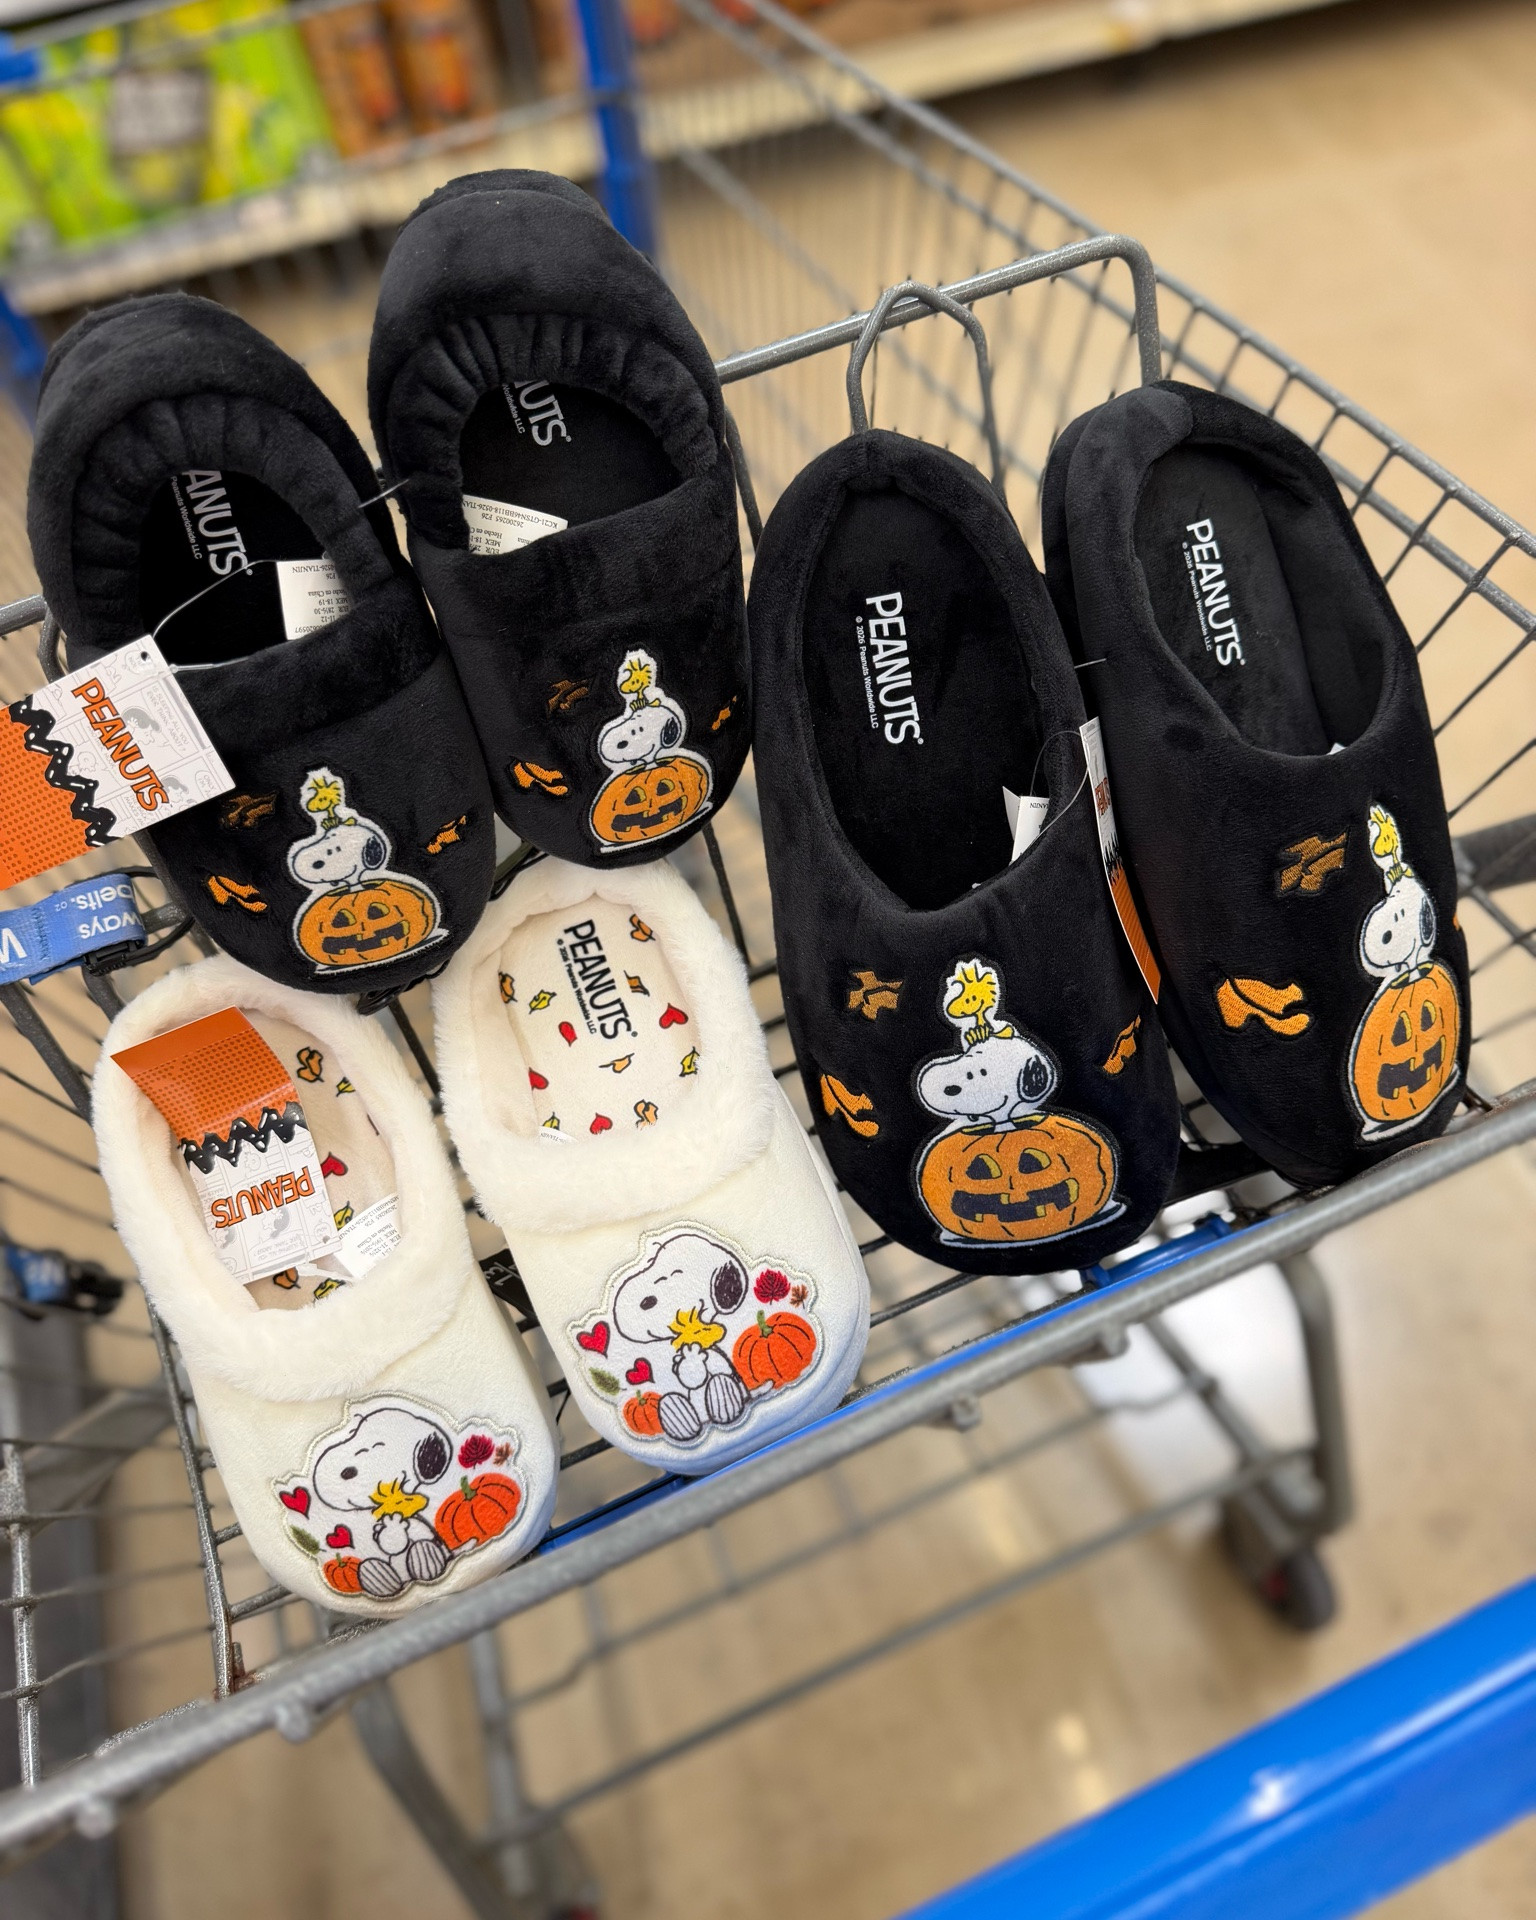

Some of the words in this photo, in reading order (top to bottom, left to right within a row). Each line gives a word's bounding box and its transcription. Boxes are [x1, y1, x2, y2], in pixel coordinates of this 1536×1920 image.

[514, 418, 526, 434] LLC
[480, 512, 492, 520] F26
[181, 506, 196, 543] Worldwide
[191, 543, 203, 560] LLC
[469, 534, 482, 543] 18-1
[483, 528, 502, 539] Hecho
[484, 538, 501, 547] MEX
[307, 589, 324, 598] China
[1187, 570, 1200, 599] Peanuts
[1194, 599, 1209, 635] Worldwide
[1203, 636, 1212, 651] LLC
[855, 625, 865, 644] 2026
[858, 645, 870, 675] Peanuts
[863, 675, 877, 713] Worldwide
[869, 713, 878, 728] LLC
[72, 678, 169, 812] PEANUTS
[178, 731, 189, 745] YOU
[81, 912, 143, 939] ways
[564, 963, 579, 988] Peanuts
[574, 988, 592, 1020] Worldwide
[586, 1020, 597, 1034] LLC
[211, 1166, 315, 1229] PEANUTS
[376, 1222, 393, 1234] Hecho
[383, 1228, 397, 1238] MEX
[355, 1236, 372, 1248] China
